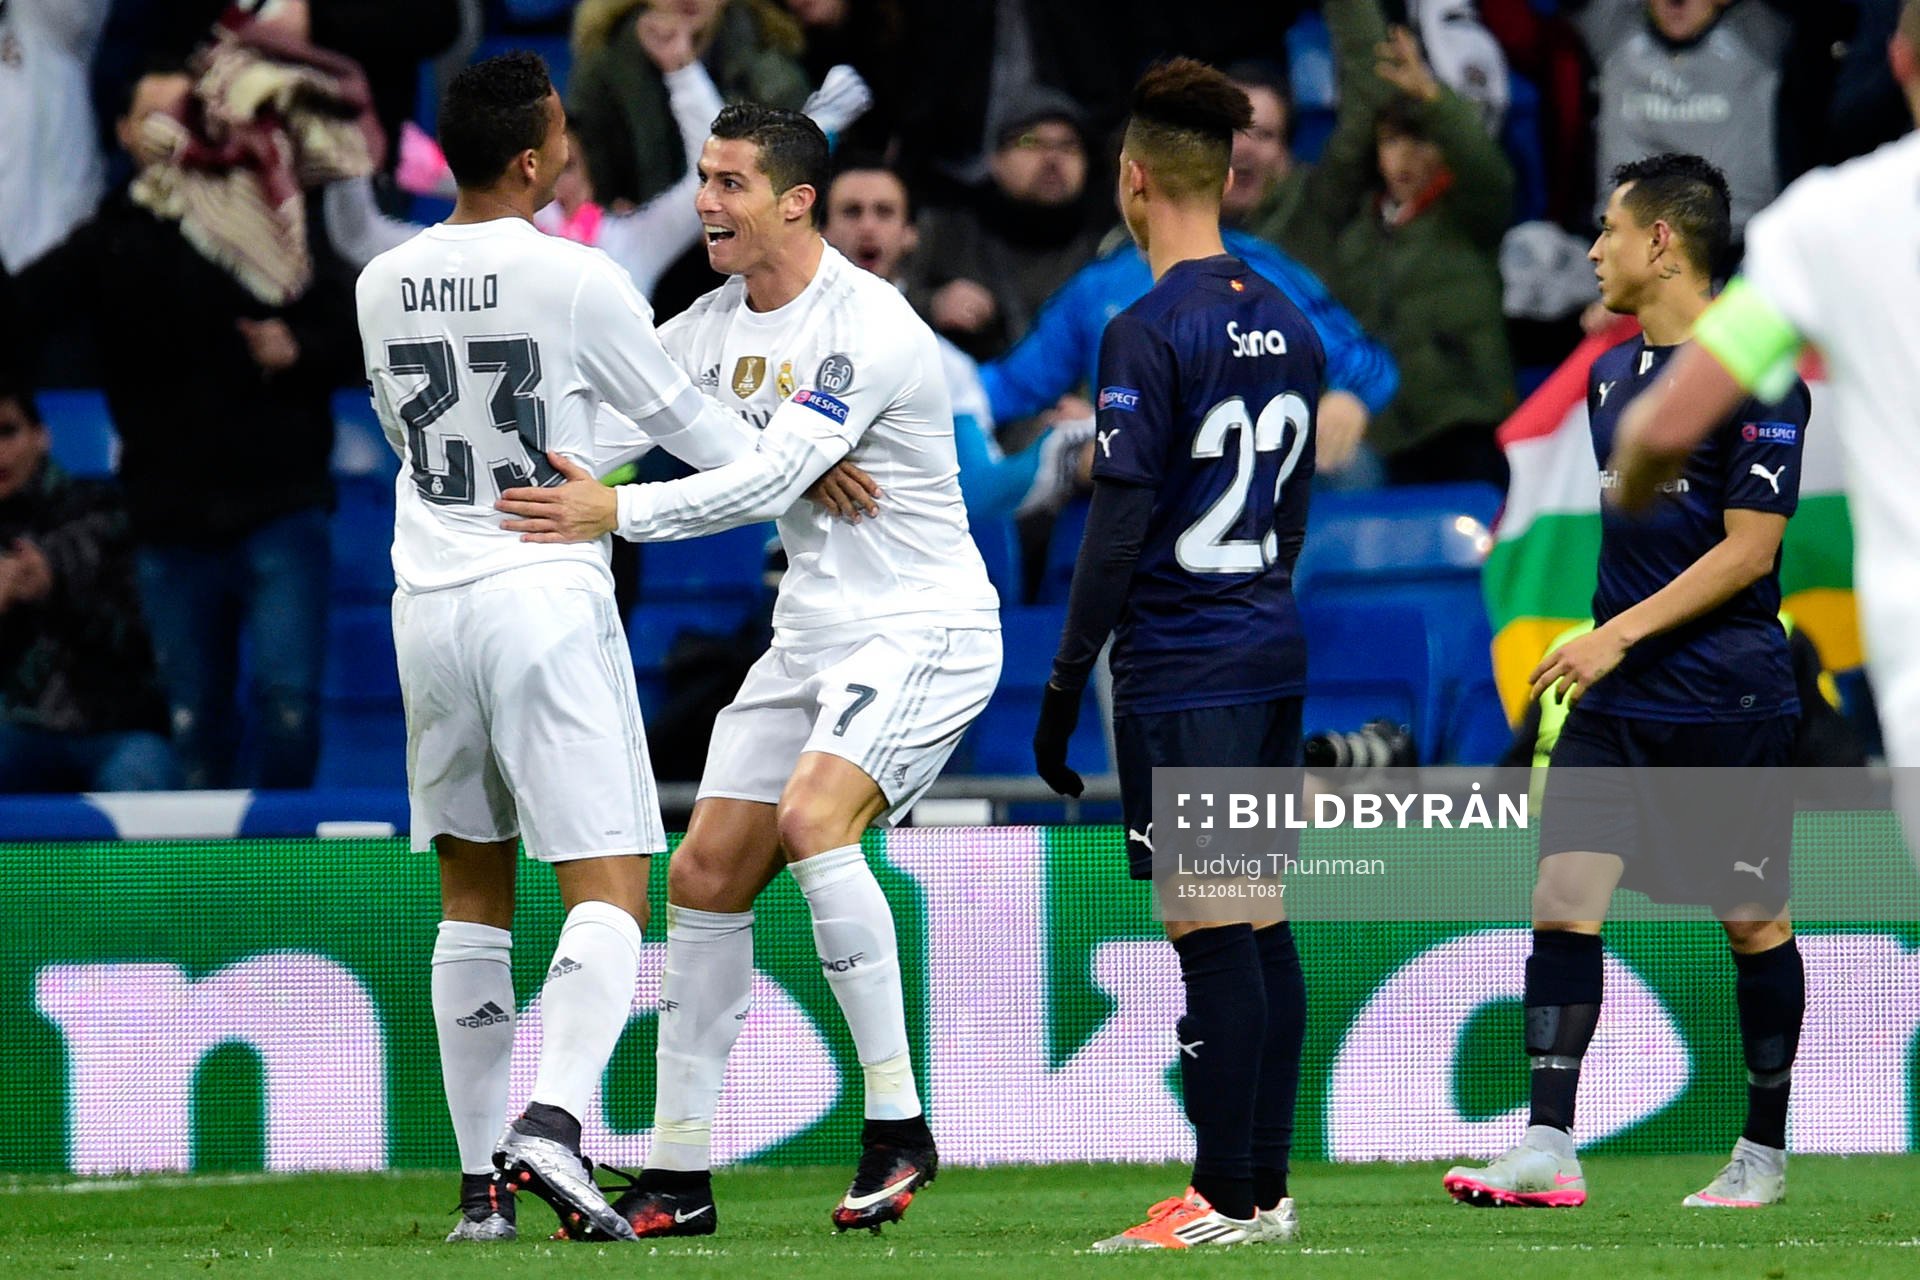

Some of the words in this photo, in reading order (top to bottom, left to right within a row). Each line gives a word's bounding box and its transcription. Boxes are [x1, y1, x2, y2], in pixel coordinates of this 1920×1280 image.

[400, 274, 498, 312] DANILO
[1226, 320, 1287, 358] Sana
[824, 375, 841, 389] 10
[383, 332, 568, 506] 23
[808, 395, 850, 420] RESPECT
[1758, 426, 1797, 440] RESPECT
[1174, 390, 1310, 574] 22
[832, 683, 878, 738] 7
[455, 1013, 510, 1029] adidas
